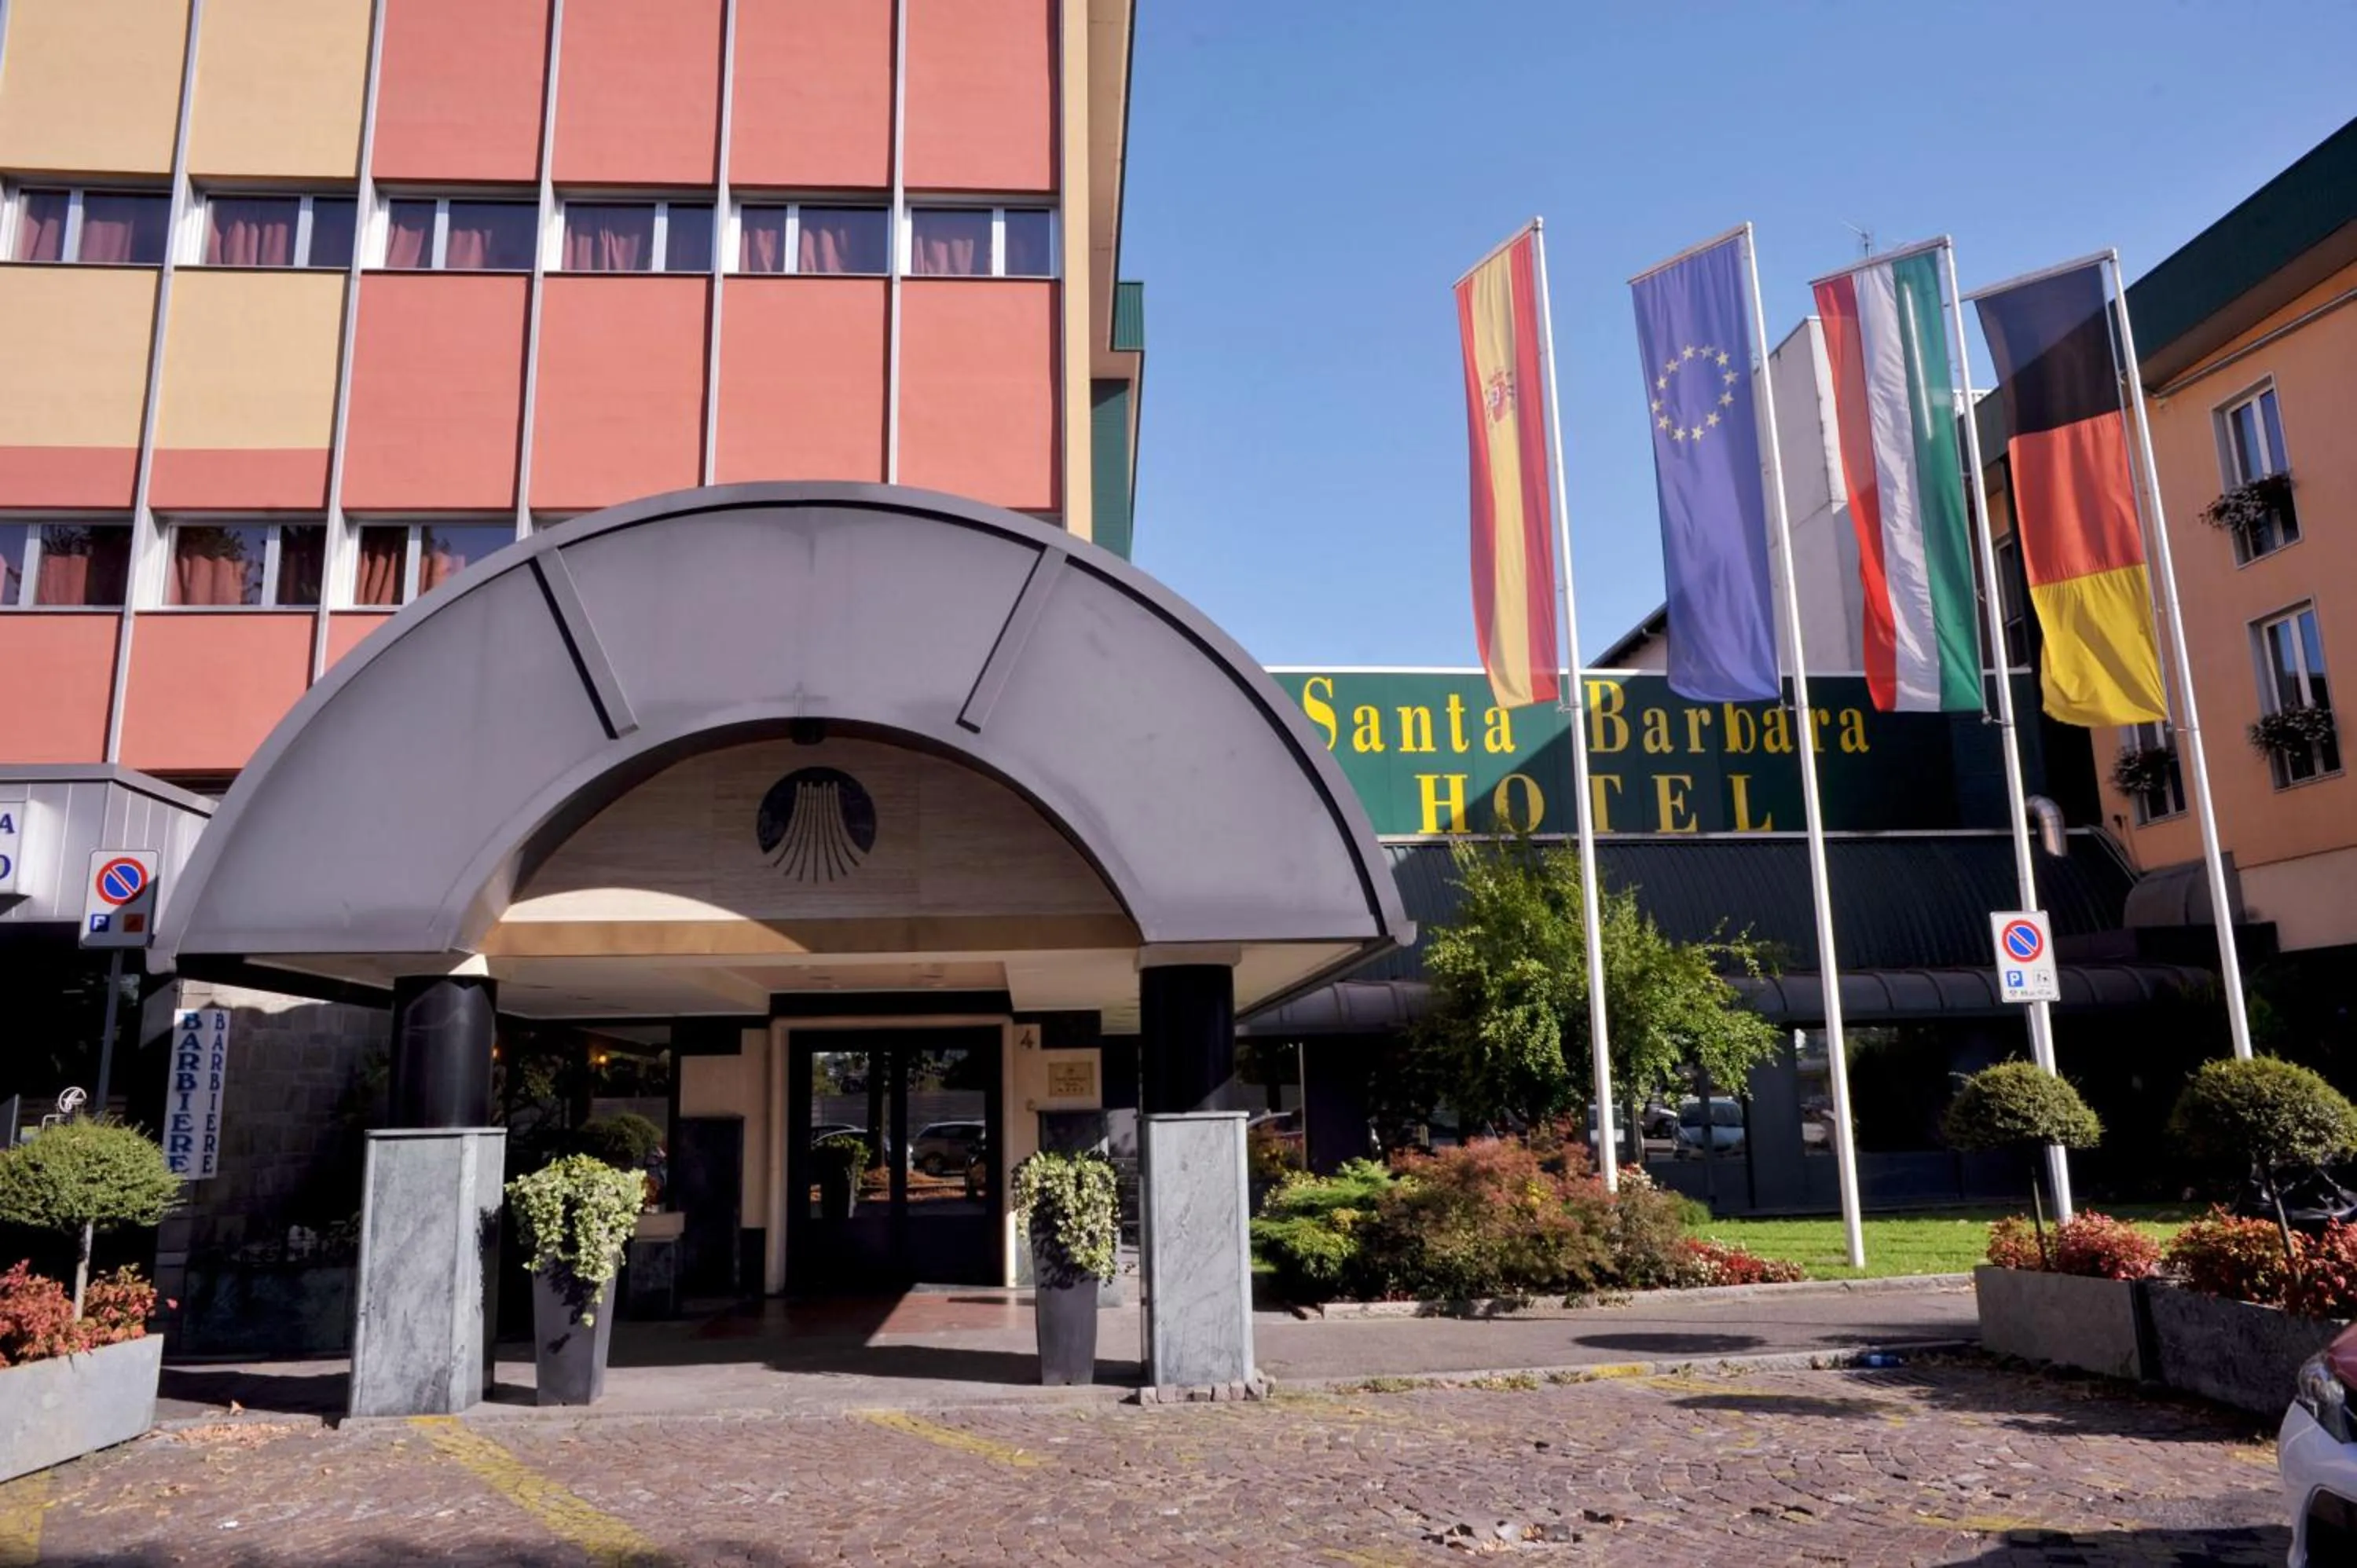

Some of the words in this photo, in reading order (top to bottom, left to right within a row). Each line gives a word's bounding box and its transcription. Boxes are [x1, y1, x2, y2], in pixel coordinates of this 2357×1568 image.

[1302, 676, 1516, 753] Santa
[1583, 680, 1870, 754] Barbara
[1413, 773, 1773, 834] HOTEL
[1020, 1030, 1036, 1049] 4
[168, 1012, 203, 1174] BARBIERE
[201, 1012, 225, 1174] BARBIERE
